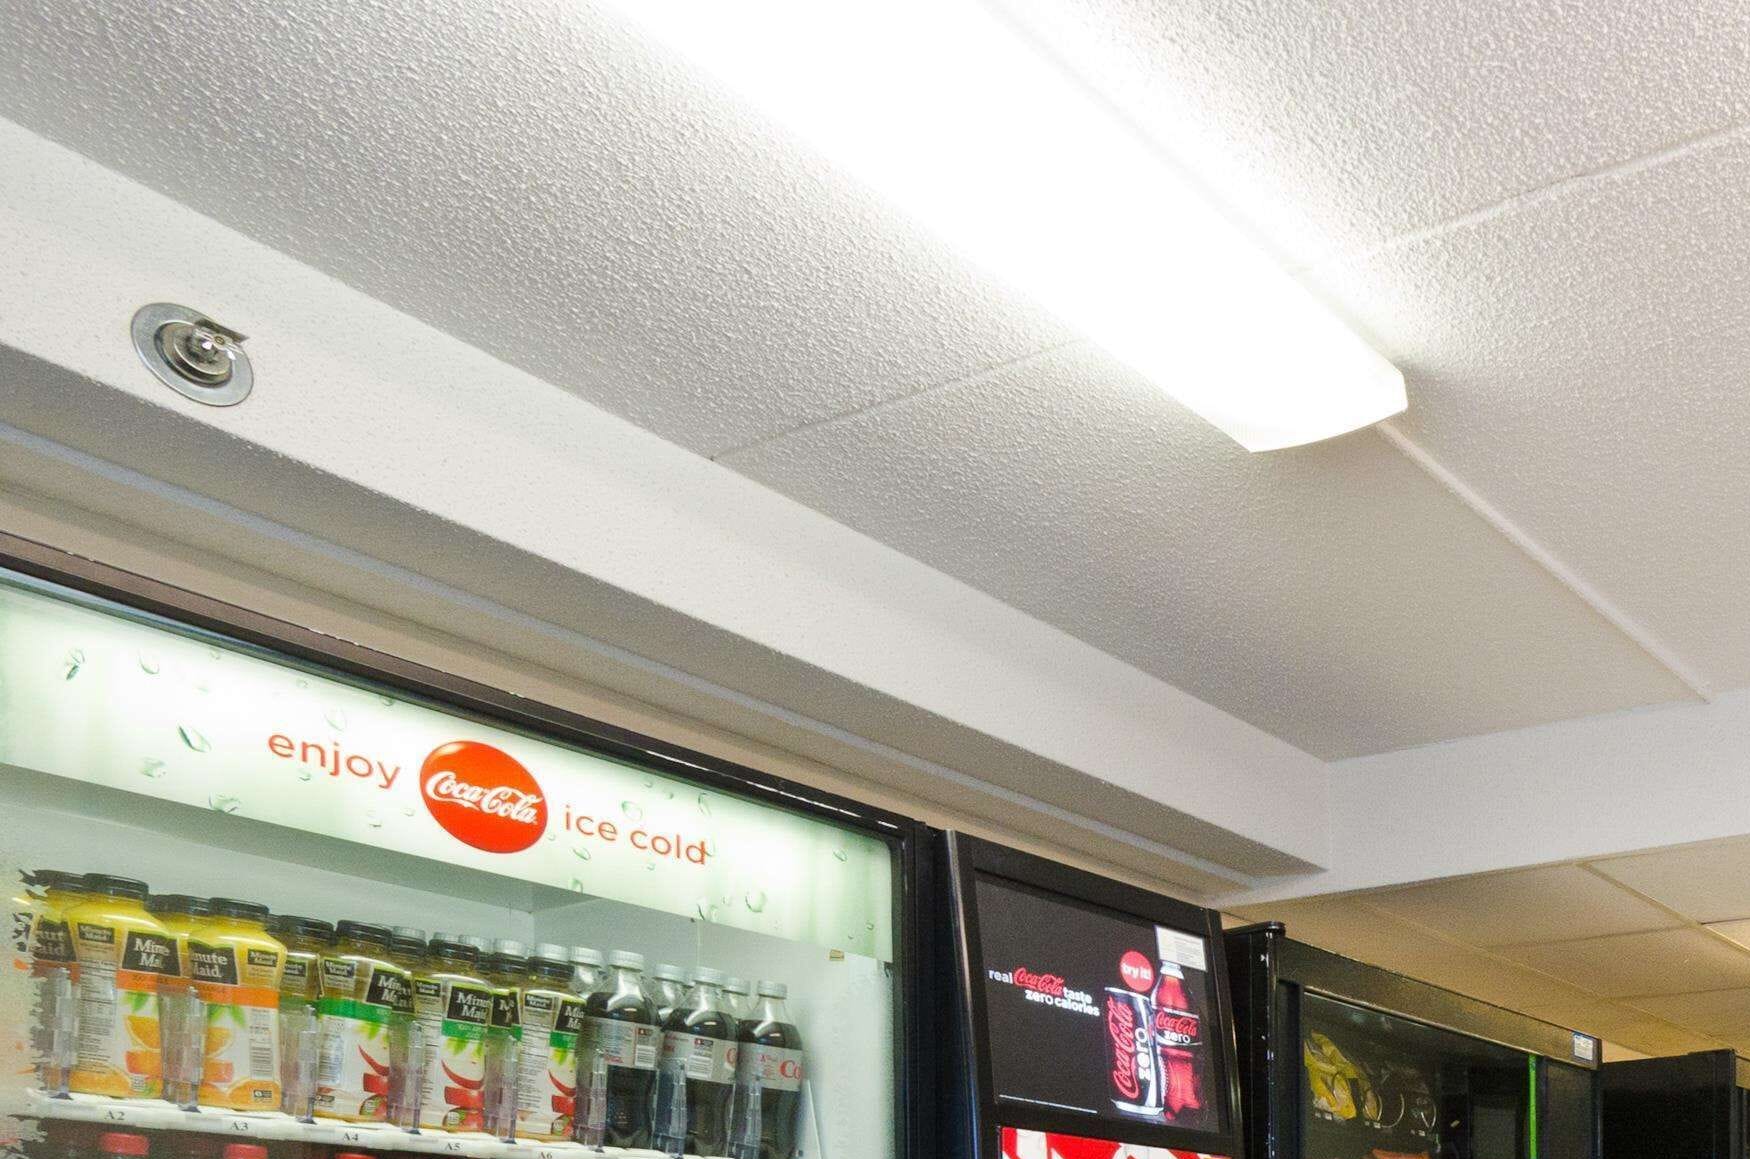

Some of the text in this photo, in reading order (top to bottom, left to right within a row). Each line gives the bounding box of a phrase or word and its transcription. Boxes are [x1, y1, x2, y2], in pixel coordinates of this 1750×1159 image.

[268, 733, 400, 790] enjoy
[426, 770, 538, 825] Coca-Cola
[565, 805, 708, 865] ice cold
[988, 966, 1093, 1005] real Coca-Cola taste
[1024, 989, 1101, 1018] zero calories
[1164, 1030, 1191, 1044] zero
[104, 1110, 125, 1121] A2
[231, 1121, 249, 1131] A3
[344, 1131, 359, 1141] A4
[447, 1142, 461, 1150] A5
